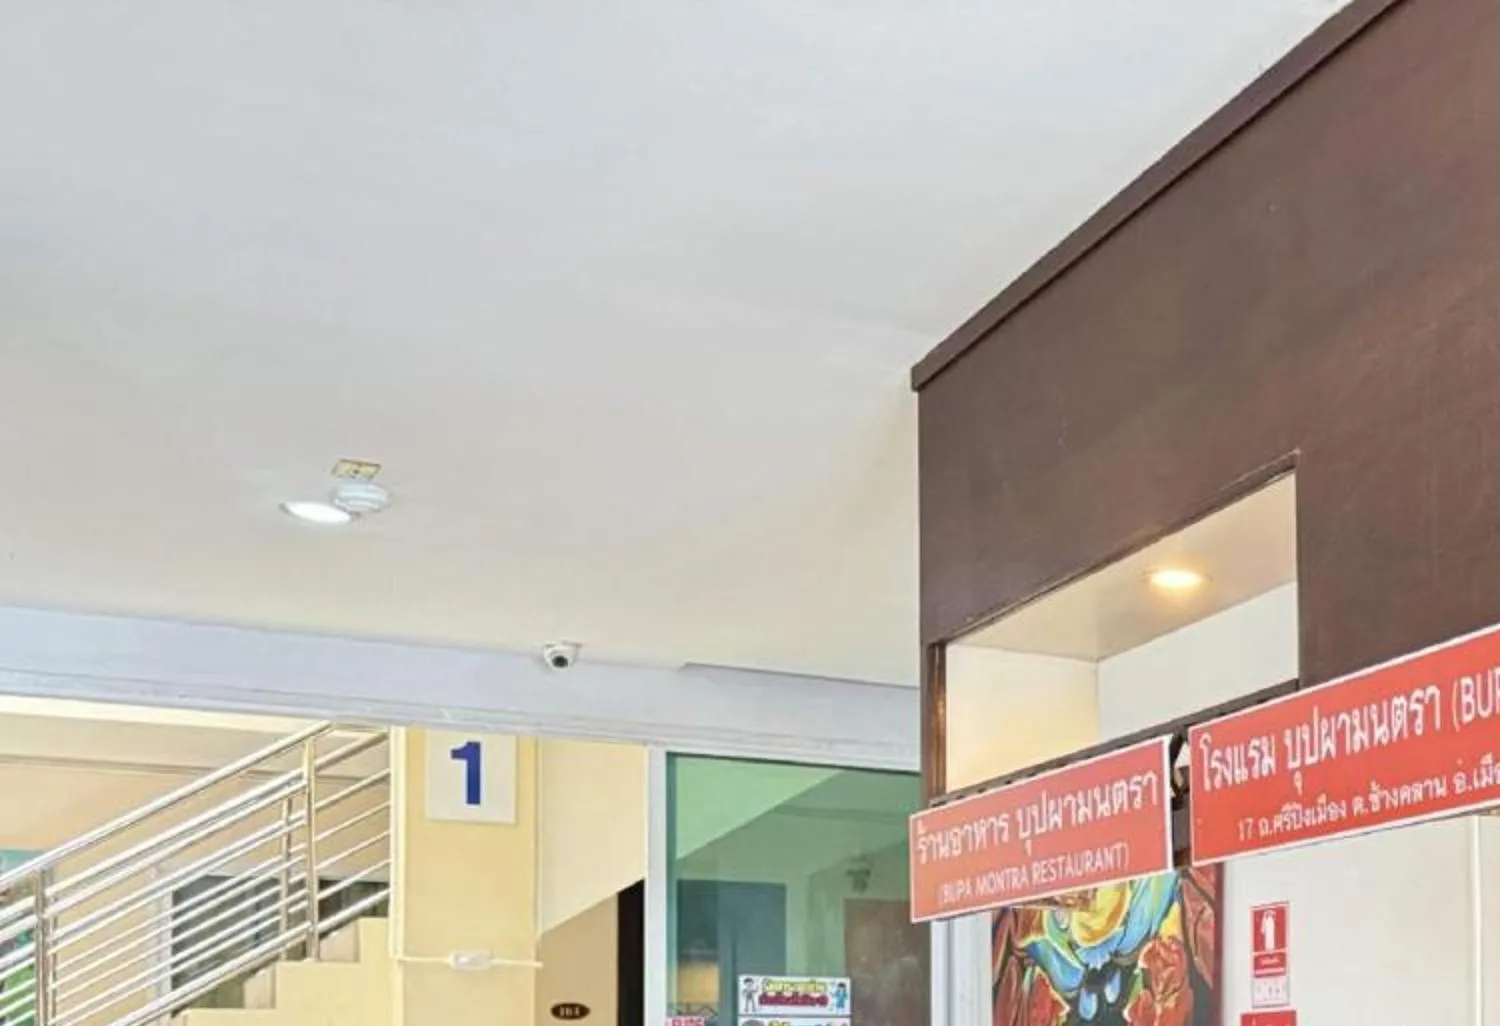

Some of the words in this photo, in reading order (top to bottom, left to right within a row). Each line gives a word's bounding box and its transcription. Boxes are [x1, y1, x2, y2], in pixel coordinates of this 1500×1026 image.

[1199, 730, 1277, 792] โรงแรม
[1283, 684, 1441, 795] บุปผามนตรา
[450, 741, 482, 806] 1
[917, 813, 1010, 866] ร้านอาหาร
[1016, 770, 1158, 857] บุปผามนตรา
[1237, 816, 1254, 842] 17
[974, 864, 1029, 898] MONTRA
